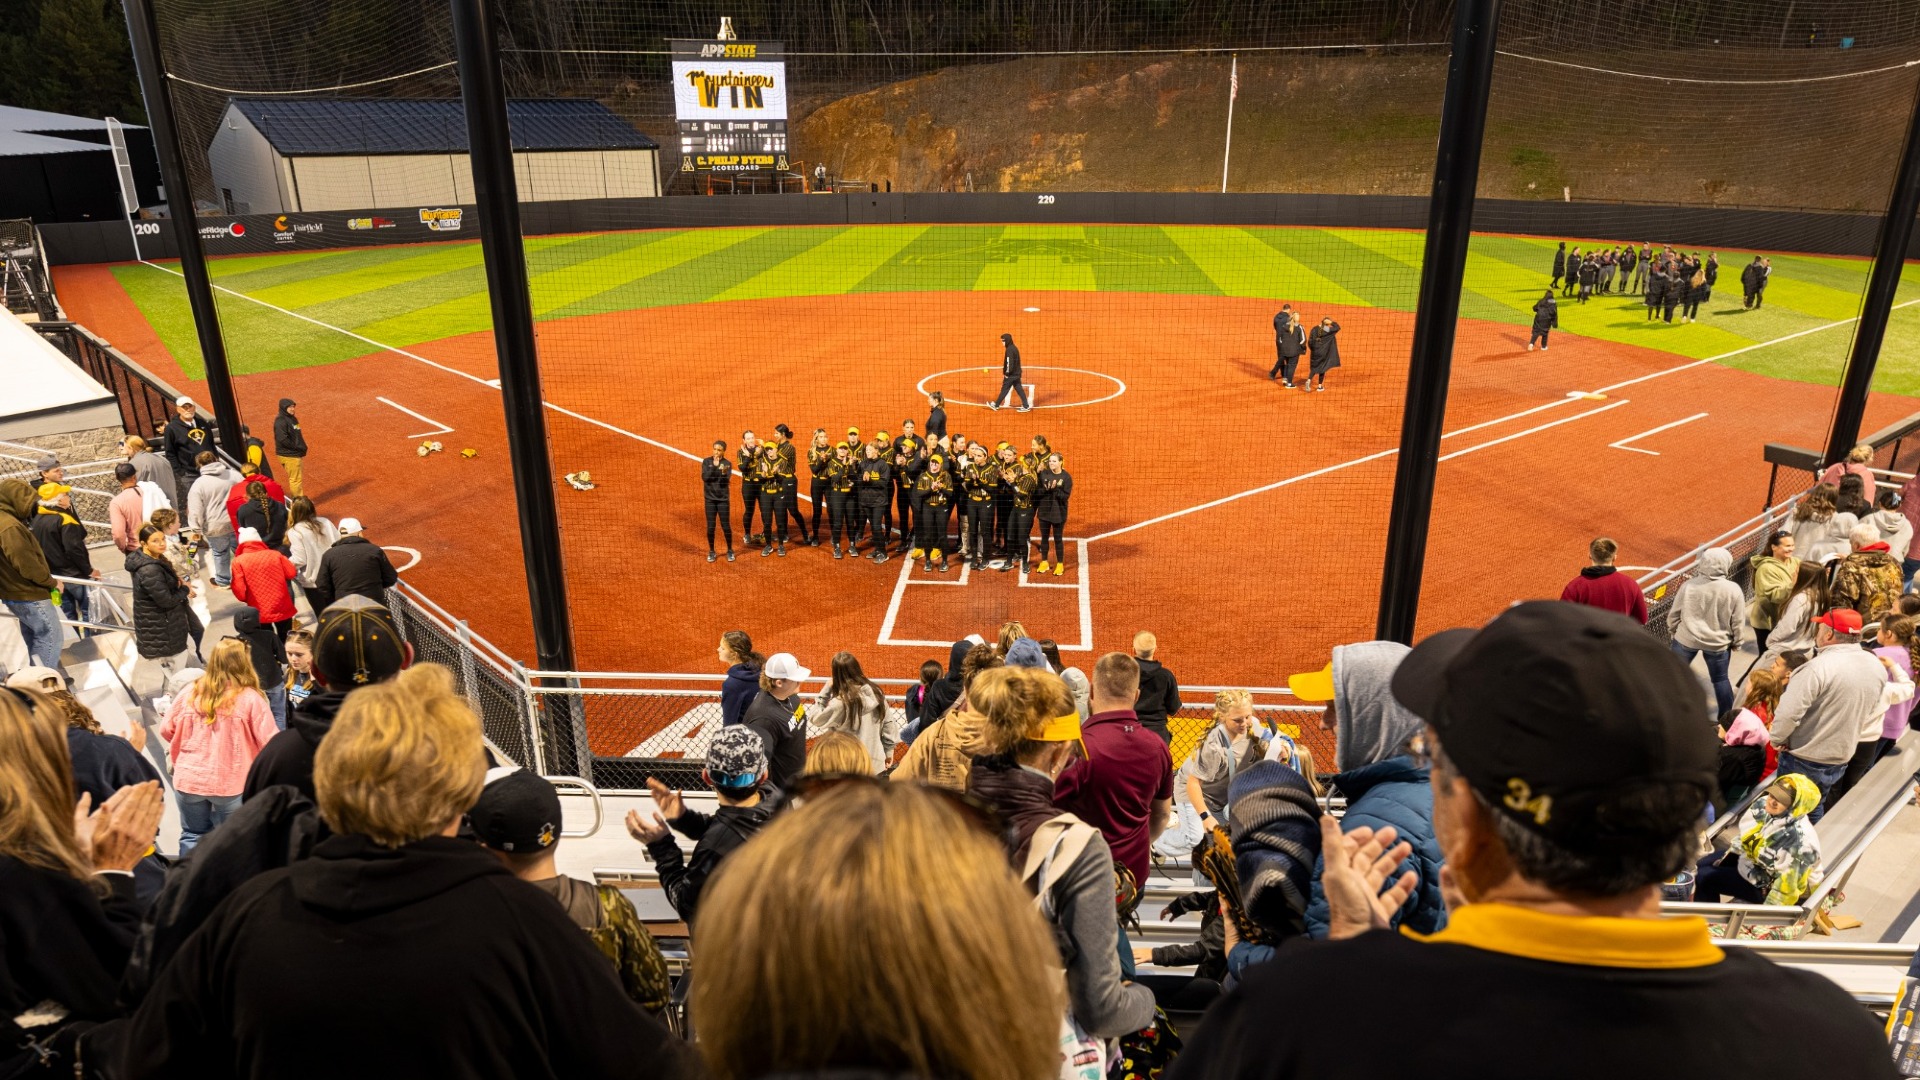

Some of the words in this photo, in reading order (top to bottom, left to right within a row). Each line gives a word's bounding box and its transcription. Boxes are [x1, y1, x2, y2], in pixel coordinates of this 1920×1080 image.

[697, 77, 764, 108] WIN
[1038, 194, 1055, 204] 220
[134, 223, 160, 235] 200
[1503, 777, 1553, 825] 34
